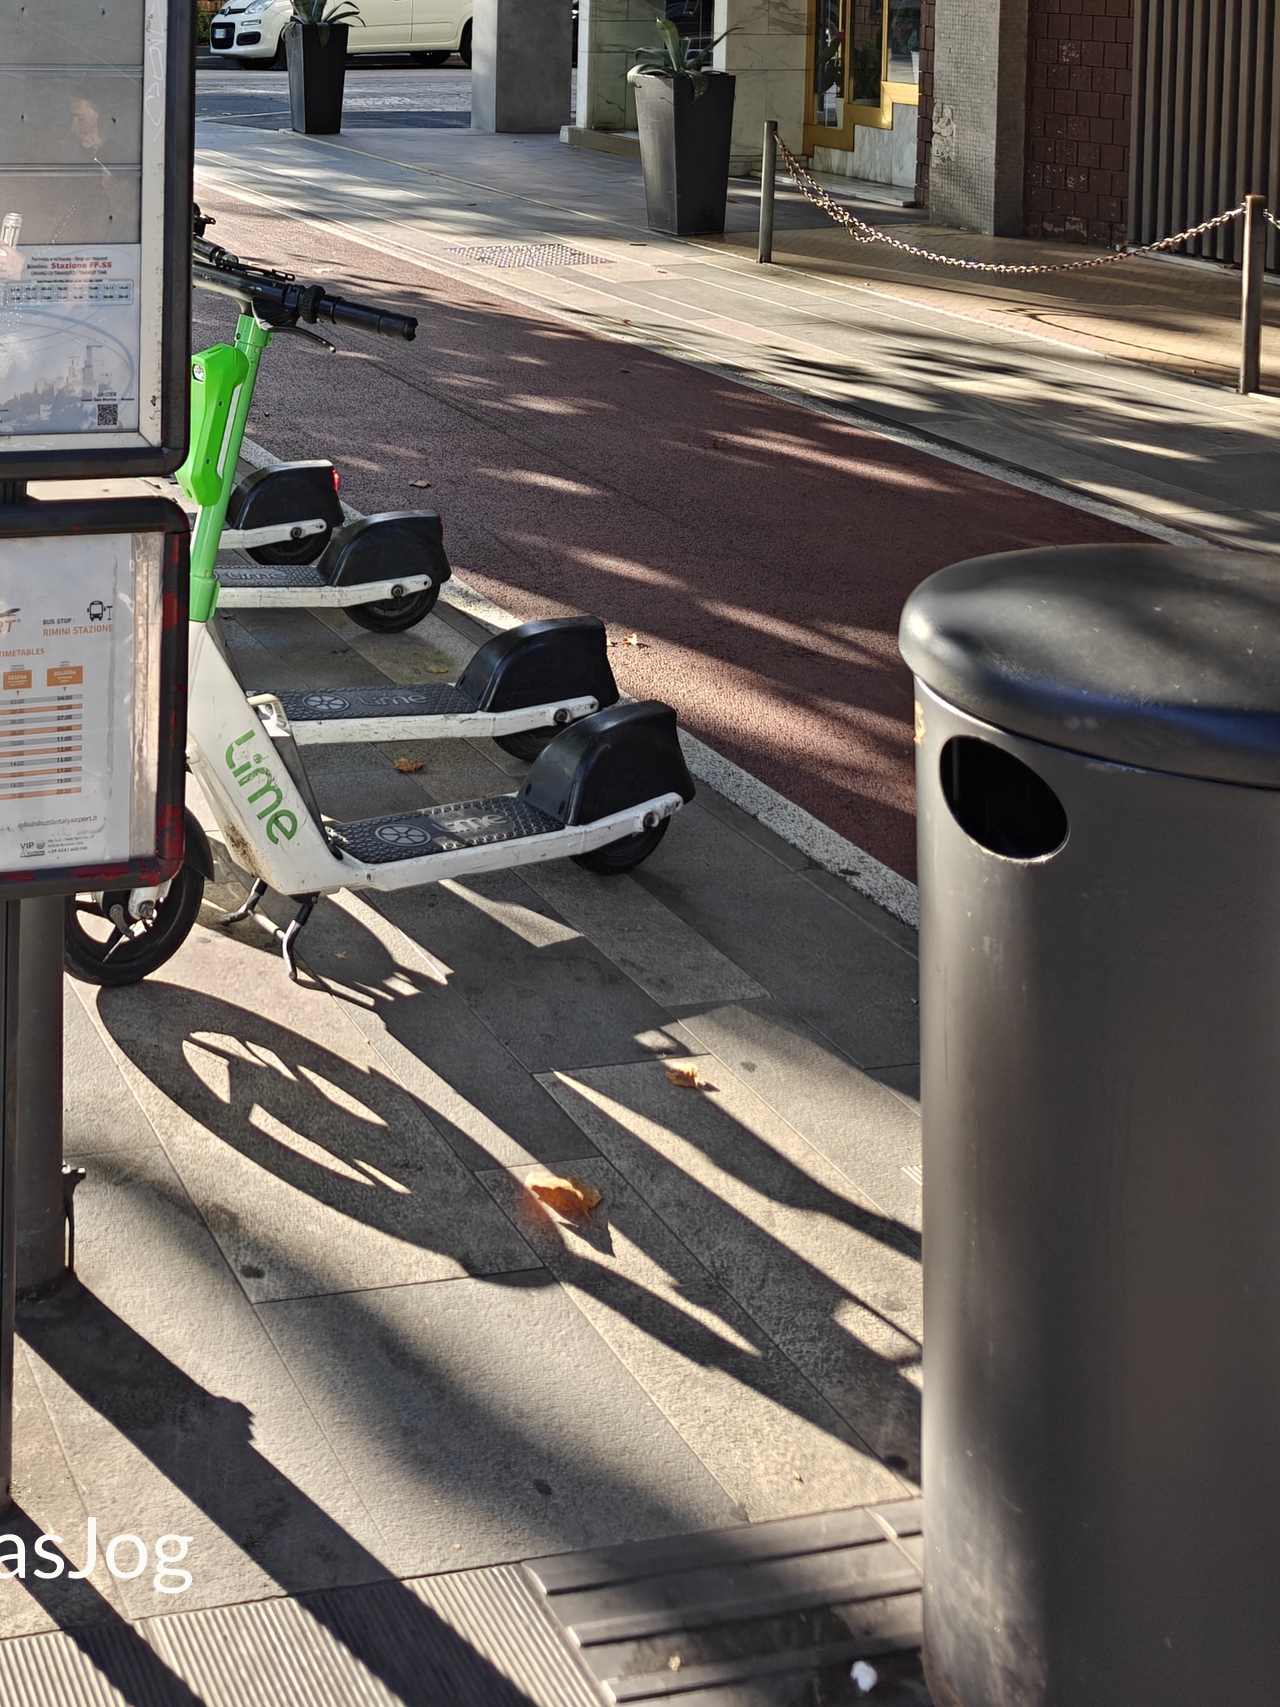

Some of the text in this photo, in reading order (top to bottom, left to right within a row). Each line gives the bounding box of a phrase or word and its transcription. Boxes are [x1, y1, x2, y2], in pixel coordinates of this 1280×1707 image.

[51, 261, 87, 269] Stazione
[43, 624, 114, 636] RIMINI STAZIONE
[358, 693, 427, 706] Lime
[225, 729, 298, 845] Lime
